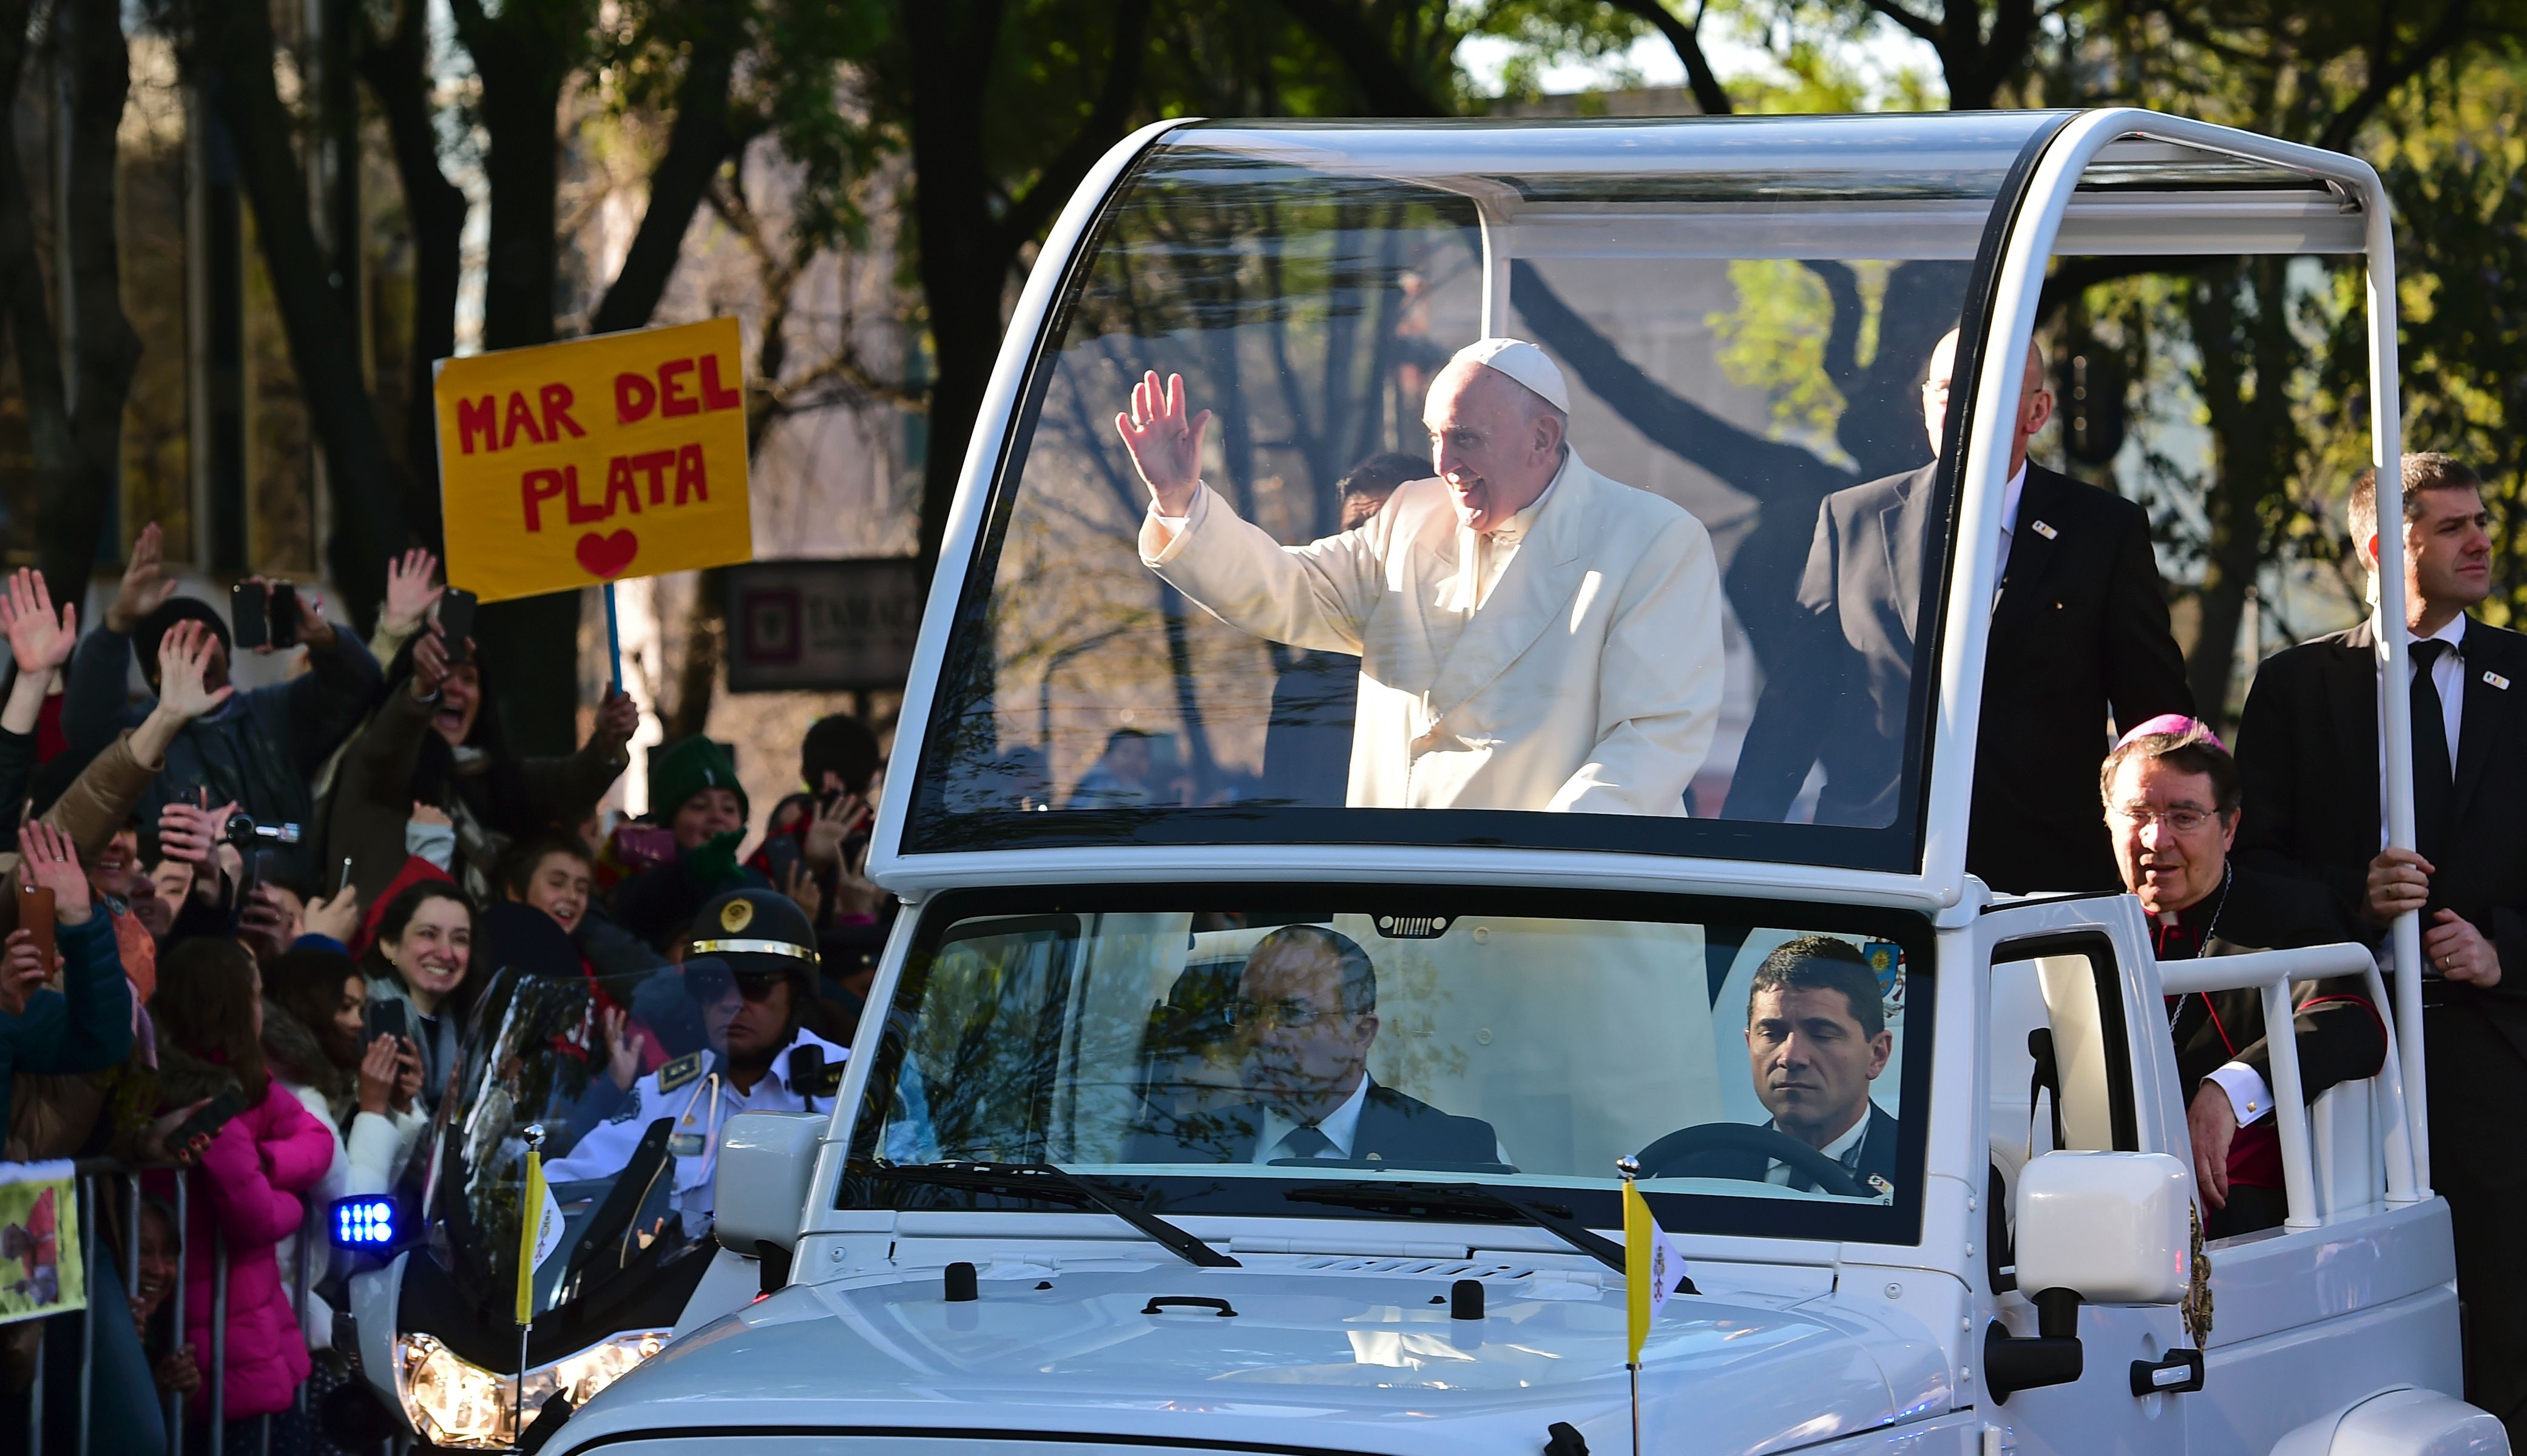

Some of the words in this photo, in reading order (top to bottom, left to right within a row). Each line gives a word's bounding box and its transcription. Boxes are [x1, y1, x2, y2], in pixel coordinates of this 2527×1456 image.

[458, 383, 586, 454] MAR
[614, 354, 741, 425] DEL
[521, 443, 708, 533] PLATA
